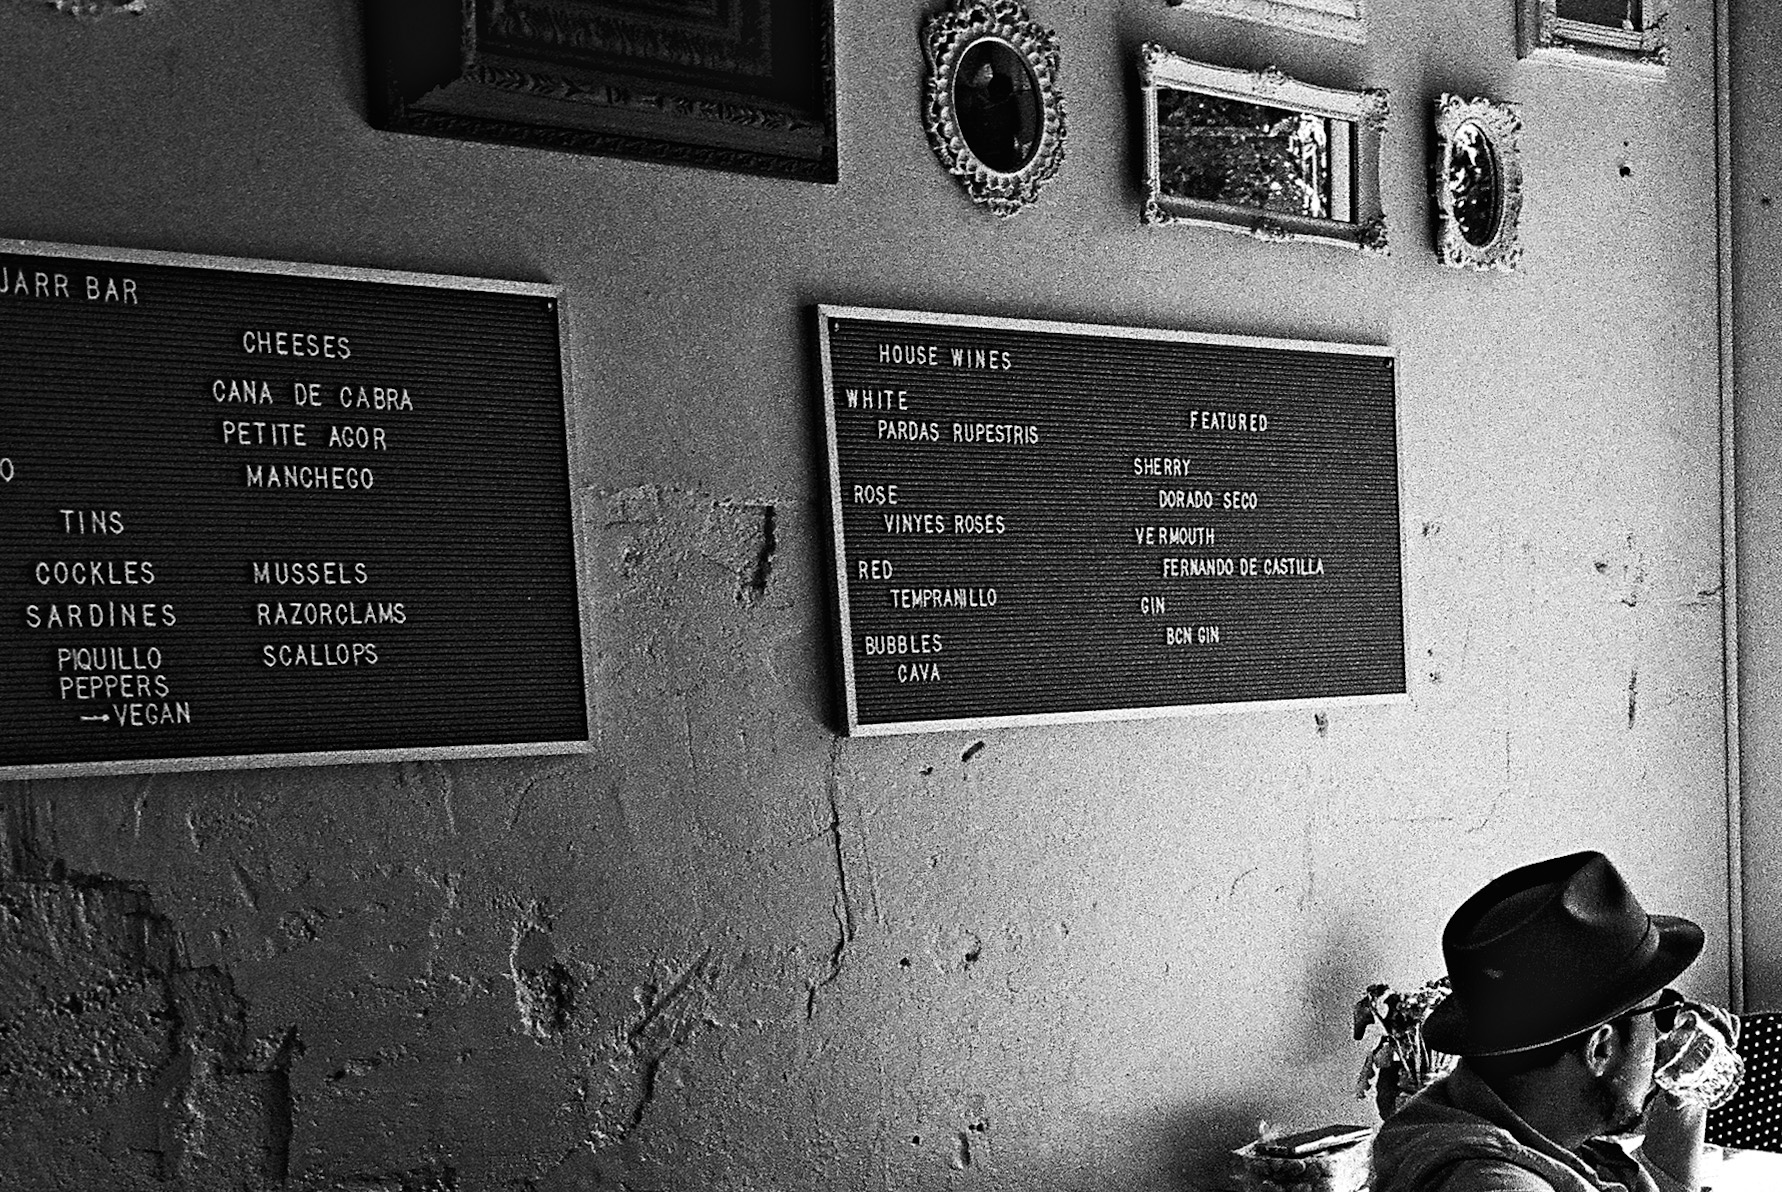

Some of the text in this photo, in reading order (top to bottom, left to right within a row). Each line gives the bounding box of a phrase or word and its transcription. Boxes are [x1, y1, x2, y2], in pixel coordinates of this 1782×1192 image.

[86, 275, 138, 304] BAR
[244, 332, 350, 358] CHEESES
[880, 345, 1011, 370] HOUSE WINES
[213, 380, 412, 409] CANA DE CABRA
[847, 390, 907, 410] WHITE
[879, 420, 1038, 444] PARDAS RUPESTRIS
[1191, 411, 1267, 432] FEATURED
[224, 421, 385, 449] PETITE AGOR
[1134, 458, 1190, 475] SHERRY
[248, 466, 373, 489] MANCHEGO
[855, 485, 897, 505] ROSE
[1159, 490, 1257, 509] DORADO SECO
[61, 510, 123, 533] TINS
[885, 515, 944, 533] VINYES
[37, 562, 154, 584] COCKLES
[254, 563, 367, 584] MUSSELS
[859, 560, 892, 579] RED
[1164, 558, 1324, 578] FERNANDO DE CASTILLA
[891, 589, 997, 608] TEMPRANILLO
[1141, 597, 1165, 614] GIN
[28, 603, 175, 627] SARDINES
[258, 603, 406, 624] RAZORCLAMS
[866, 634, 942, 655] BUBBLES
[1167, 627, 1219, 645] BCN GIN
[58, 648, 161, 671] PIQUILLO
[264, 644, 377, 666] SCALLOPS
[898, 664, 940, 682] CAVA
[60, 674, 169, 702] PEPPERS
[112, 703, 190, 727] VEGAN
